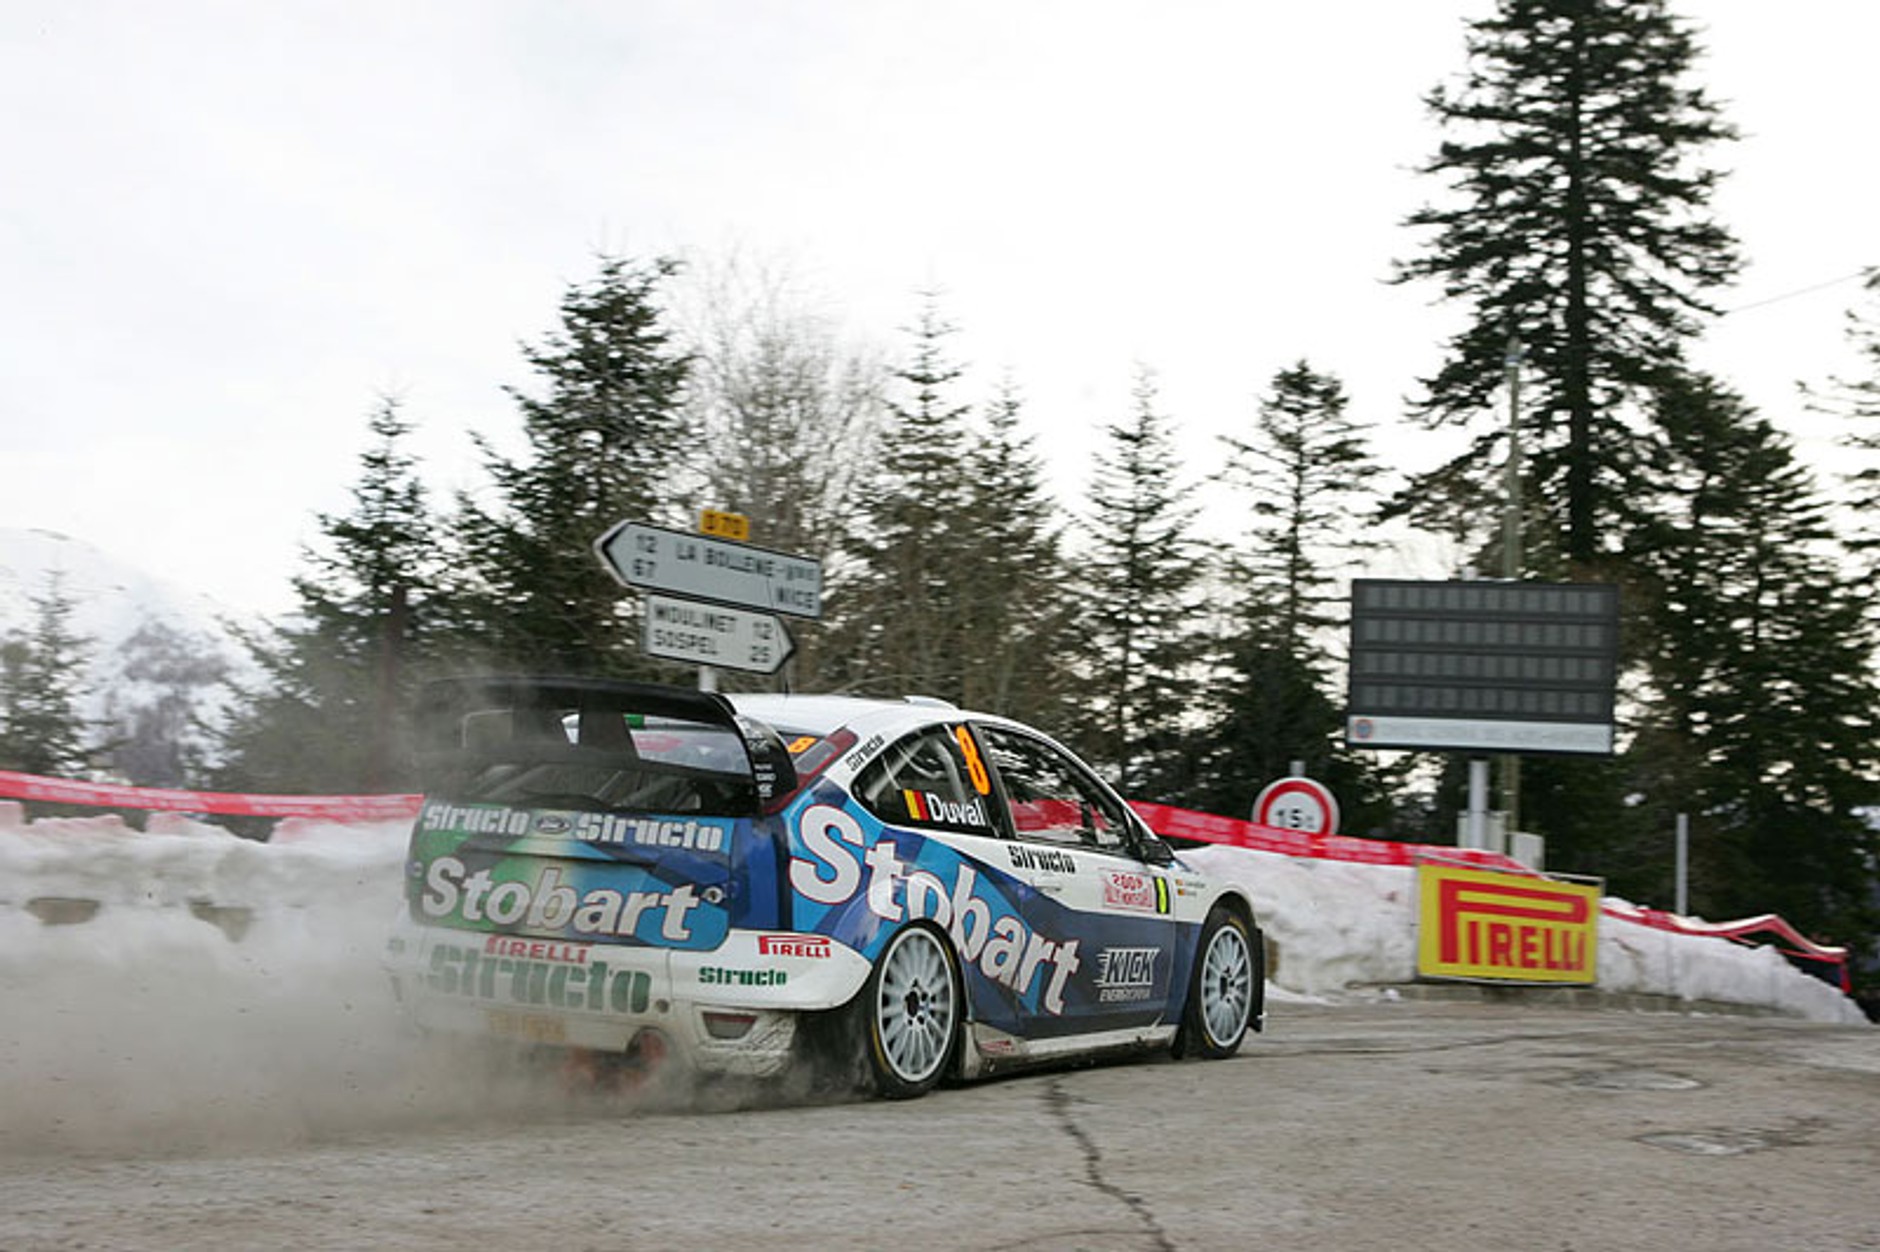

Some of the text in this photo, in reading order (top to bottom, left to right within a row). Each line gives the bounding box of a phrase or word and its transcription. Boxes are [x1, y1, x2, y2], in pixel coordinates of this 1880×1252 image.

[675, 540, 697, 561] LA
[775, 585, 815, 610] NICE
[654, 603, 738, 633] MOULINET
[654, 626, 719, 655] SOSPEL
[957, 725, 990, 796] 8
[925, 792, 986, 826] Duval
[423, 804, 531, 836] Structo
[576, 812, 723, 851] Structo
[1008, 845, 1076, 874] Structo
[422, 855, 701, 941] Stobart
[790, 803, 1080, 1016] Stobart
[1438, 878, 1590, 972] PIRELLI
[758, 934, 832, 958] PIRELLI
[698, 966, 788, 986] Structo
